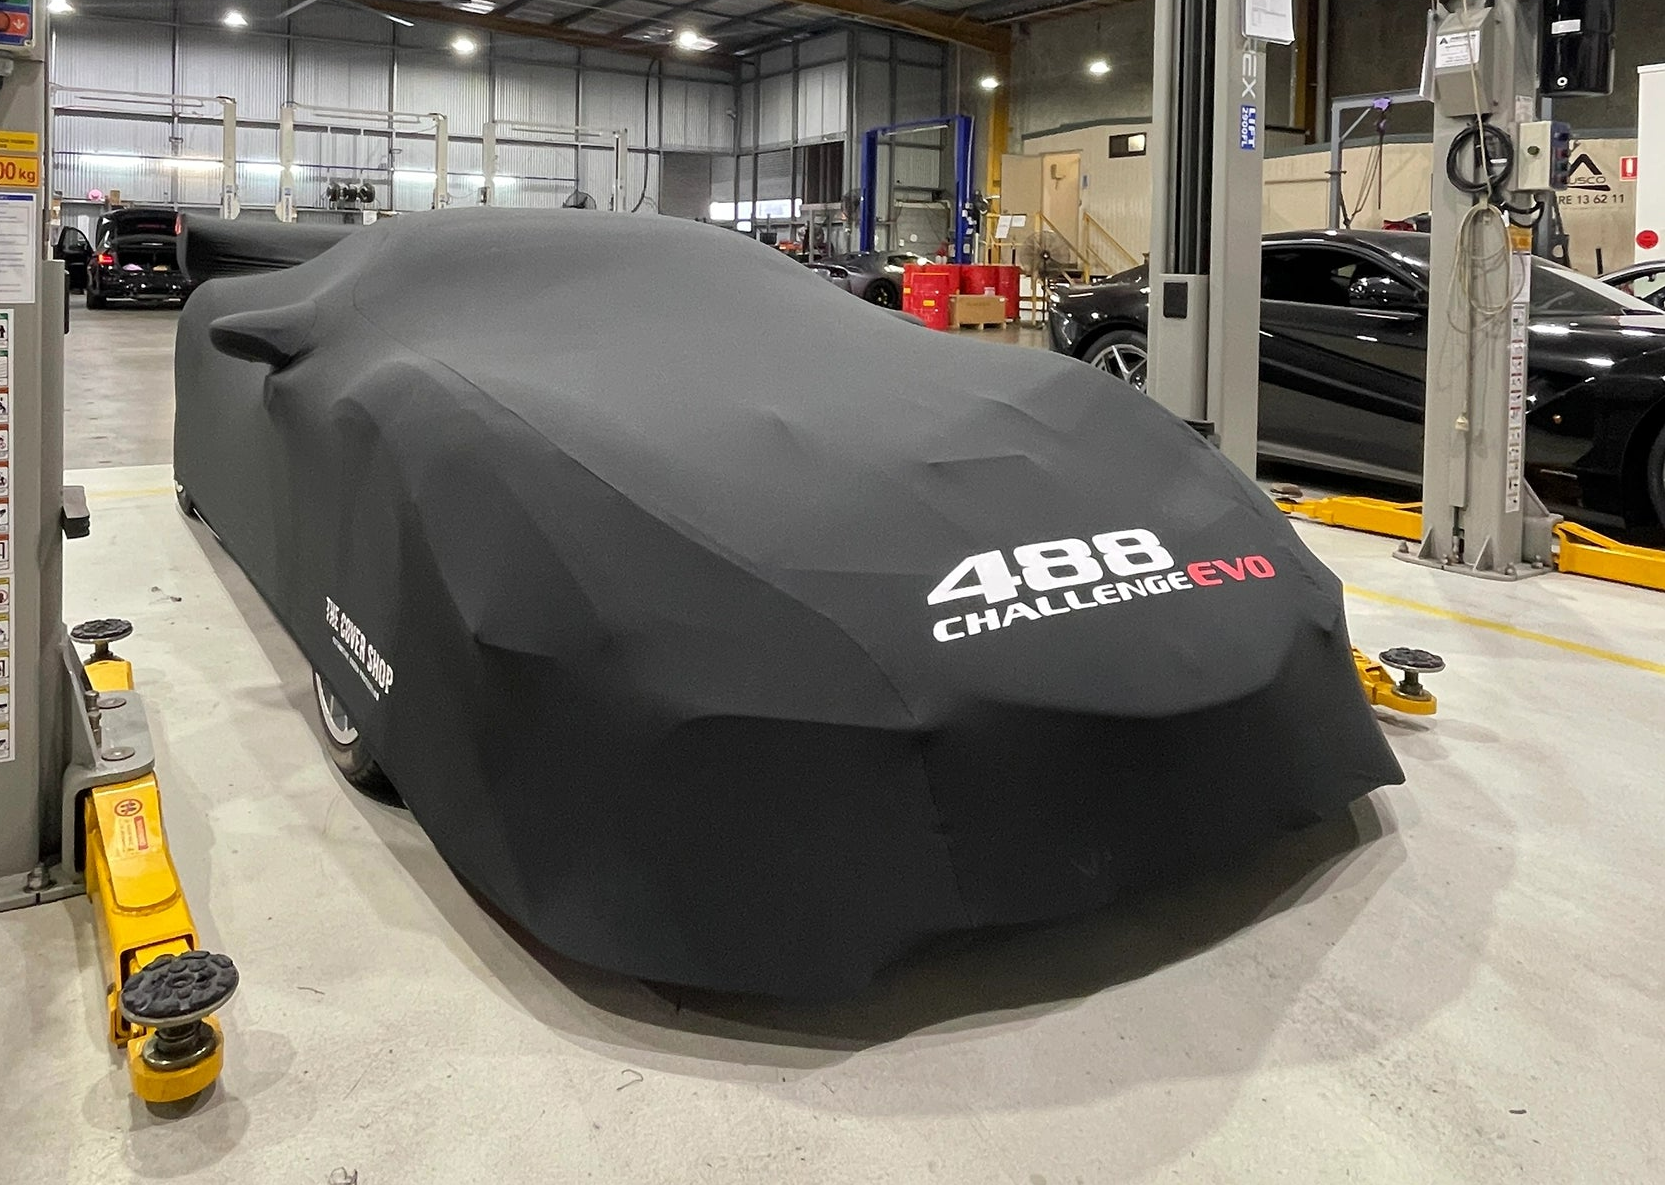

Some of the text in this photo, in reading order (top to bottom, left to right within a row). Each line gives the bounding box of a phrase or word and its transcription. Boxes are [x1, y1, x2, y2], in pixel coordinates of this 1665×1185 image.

[1241, 107, 1249, 148] 2900FL
[1248, 107, 1257, 148] LIFT
[19, 168, 36, 183] kg
[1577, 194, 1590, 204] 13
[1593, 194, 1608, 204] 62
[1612, 193, 1625, 203] 11
[927, 528, 1175, 606] 488
[932, 555, 1276, 643] CHALLENGE EVO
[326, 596, 340, 632] THE
[340, 612, 366, 664] COVER
[366, 643, 394, 695] SHOP
